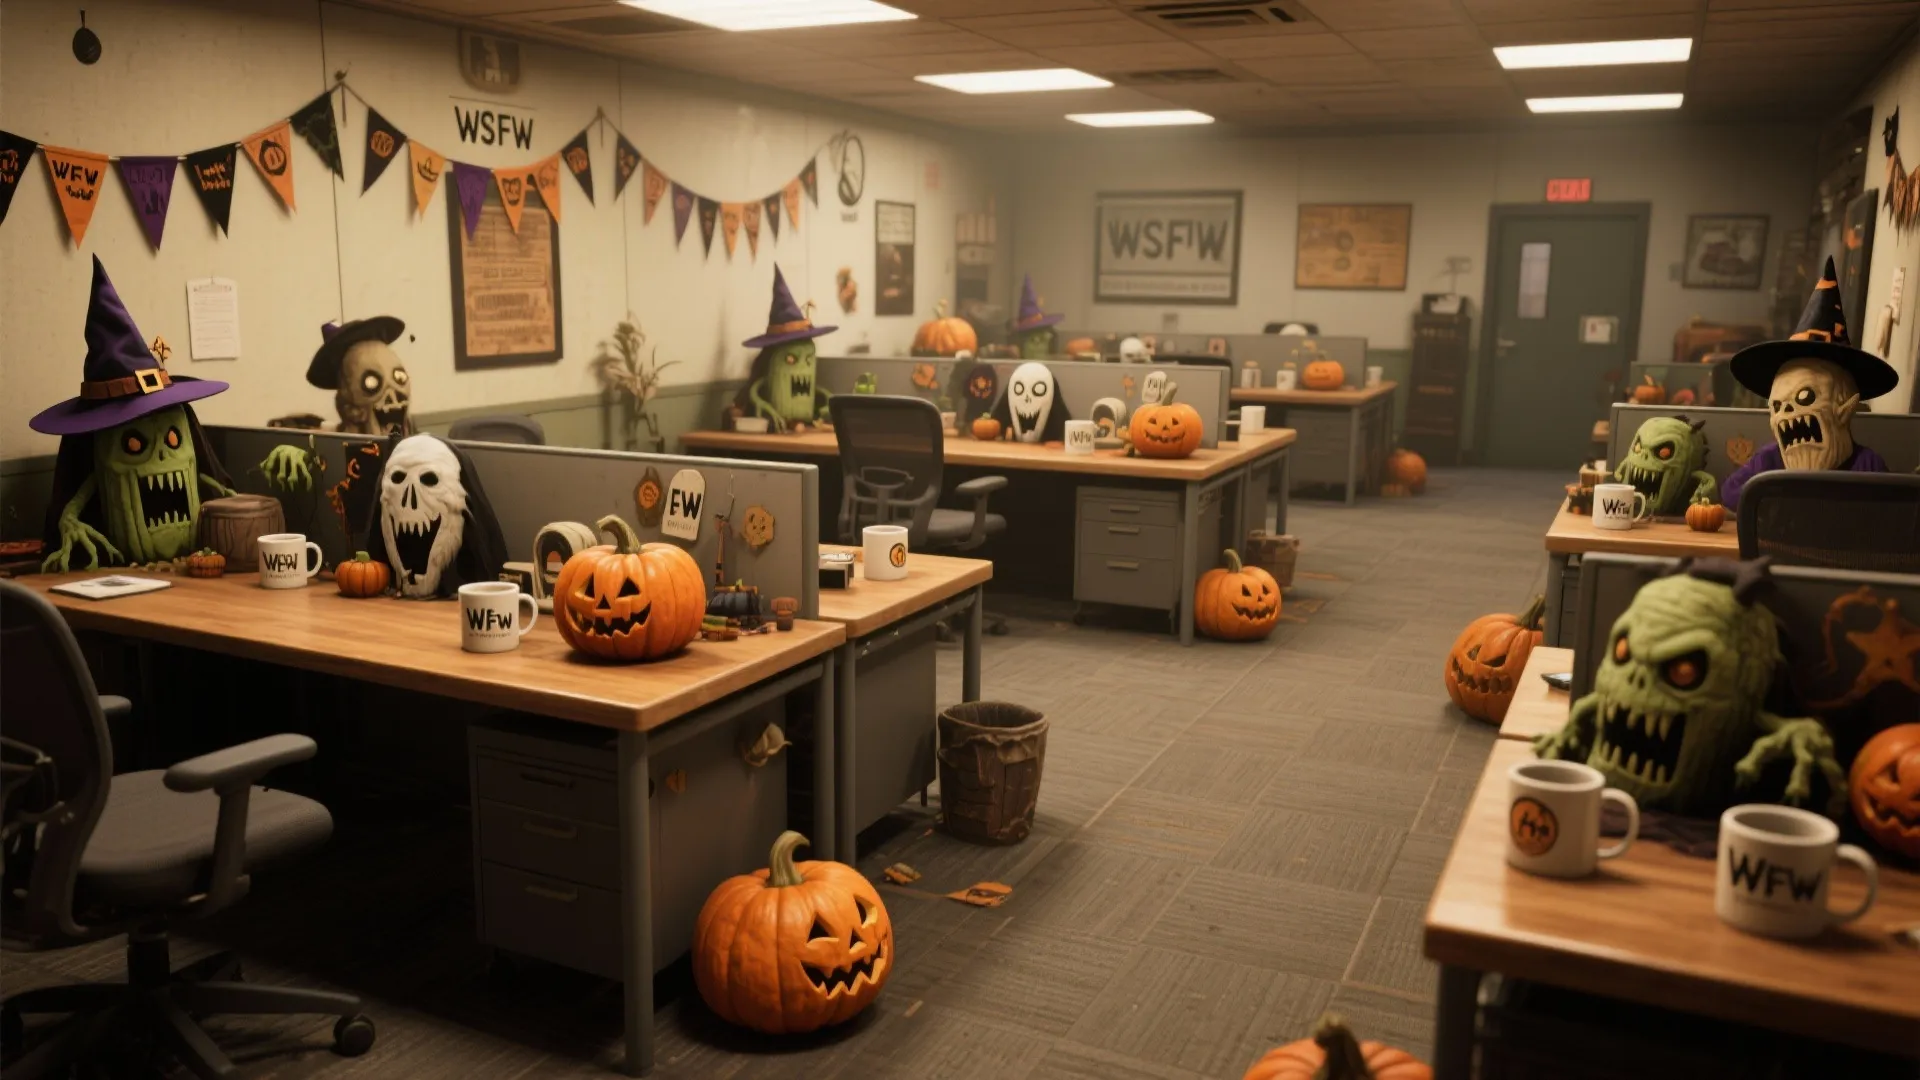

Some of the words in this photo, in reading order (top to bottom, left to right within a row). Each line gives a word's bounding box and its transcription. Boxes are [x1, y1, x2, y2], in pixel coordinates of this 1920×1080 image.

[454, 105, 533, 150] WSFW
[51, 159, 98, 186] WFW
[1729, 845, 1823, 902] WFW
